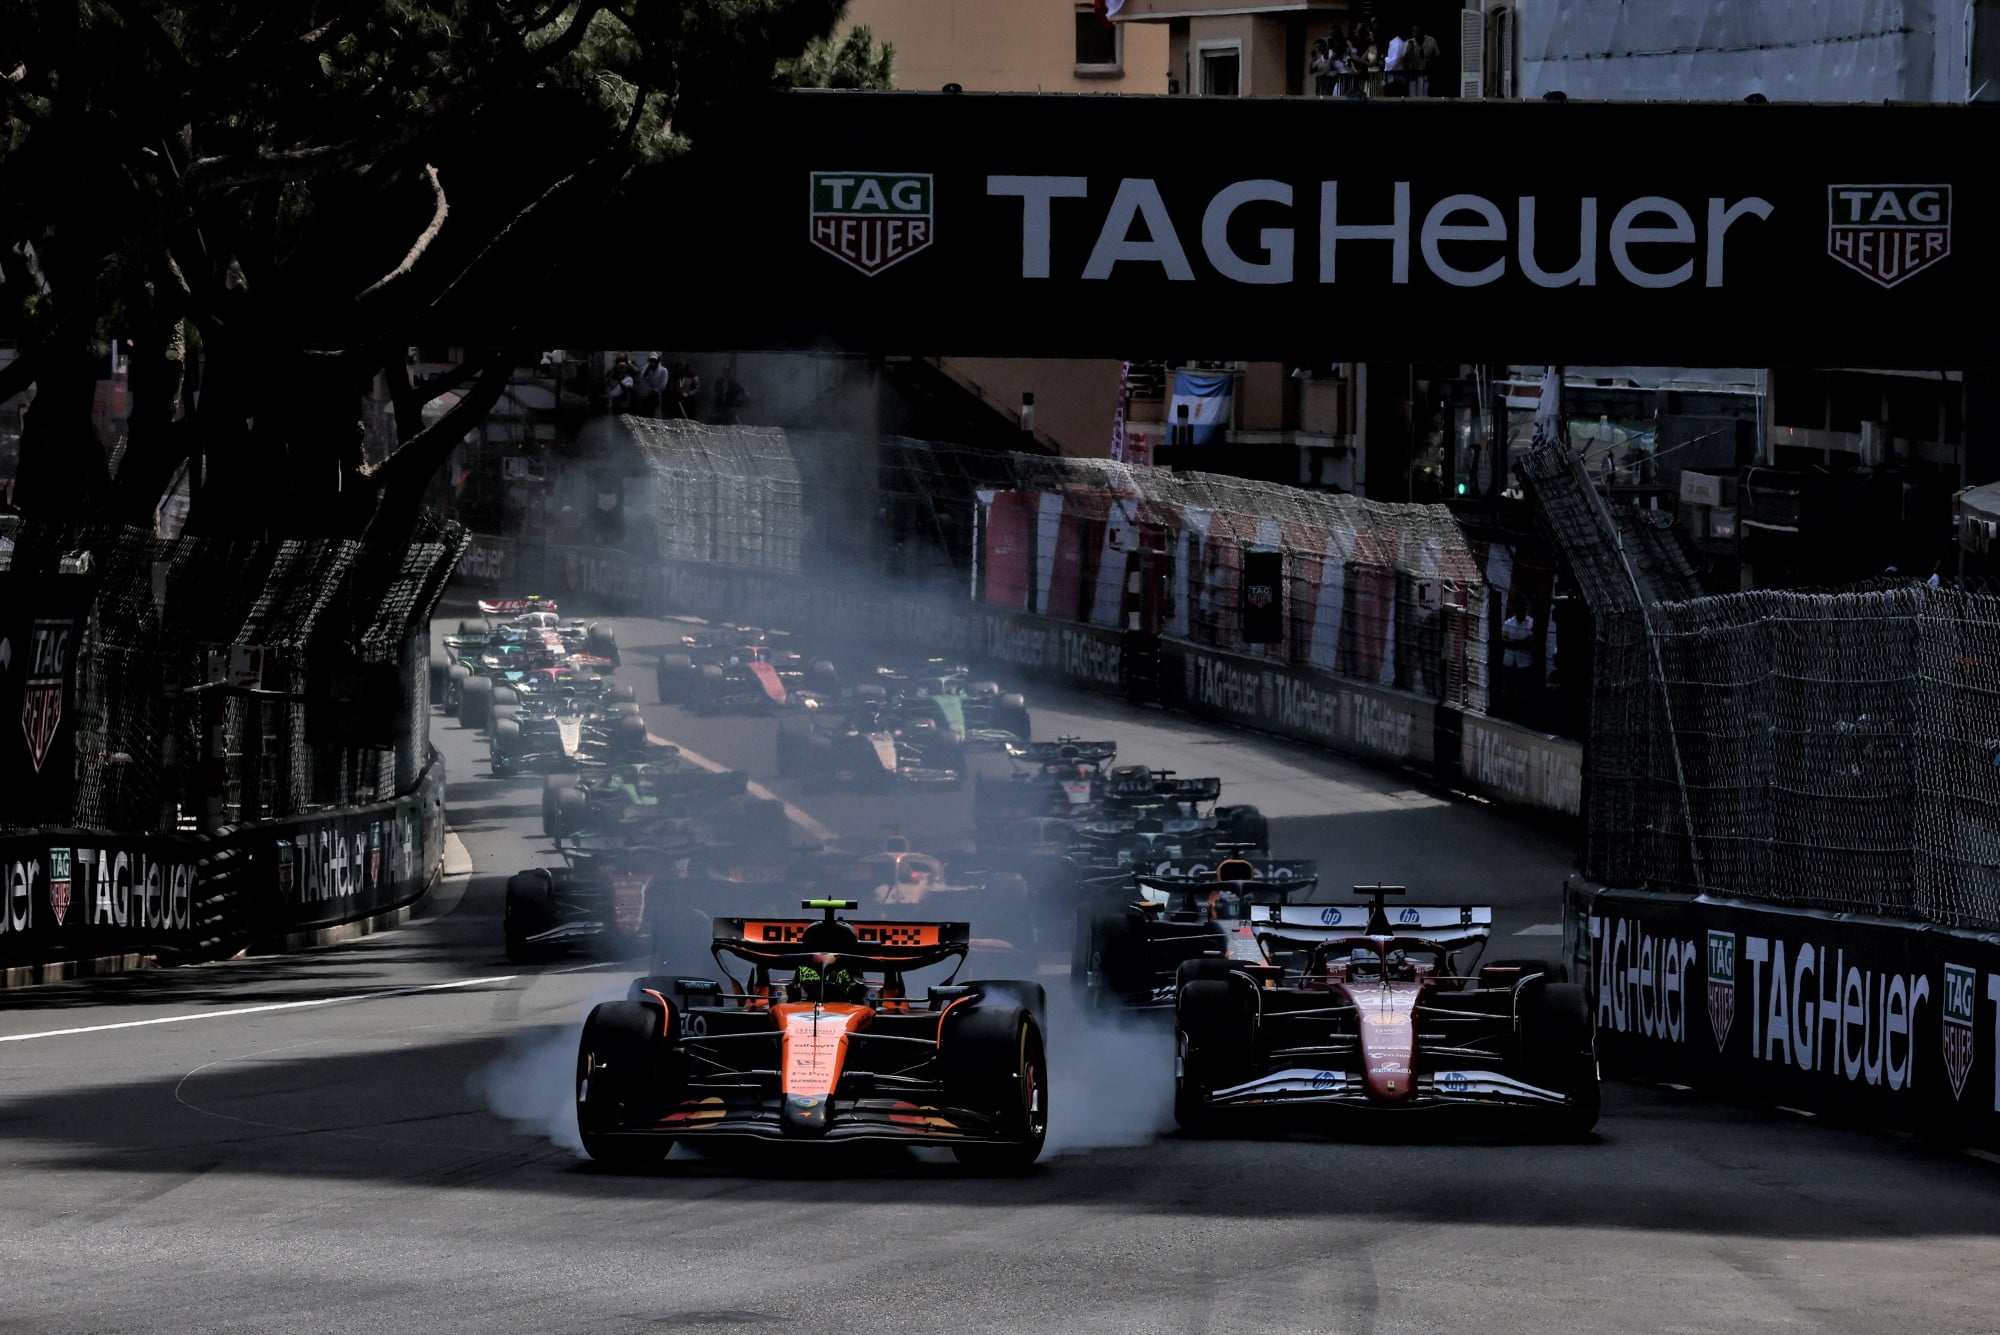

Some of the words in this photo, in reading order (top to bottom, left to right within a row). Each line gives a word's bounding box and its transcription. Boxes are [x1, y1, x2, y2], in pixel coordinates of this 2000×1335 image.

[821, 178, 922, 211] TAG
[1839, 191, 1941, 223] TAG
[817, 219, 927, 268] HEUER
[1835, 231, 1945, 280] HEUER
[34, 629, 69, 674] TAG
[50, 853, 70, 877] TAG
[763, 926, 804, 942] OK
[1322, 908, 1341, 926] hp
[858, 928, 919, 945] OKX
[1710, 938, 1732, 977] TAG
[1946, 972, 1973, 1017] TAG
[1944, 1025, 1971, 1090] HEUER
